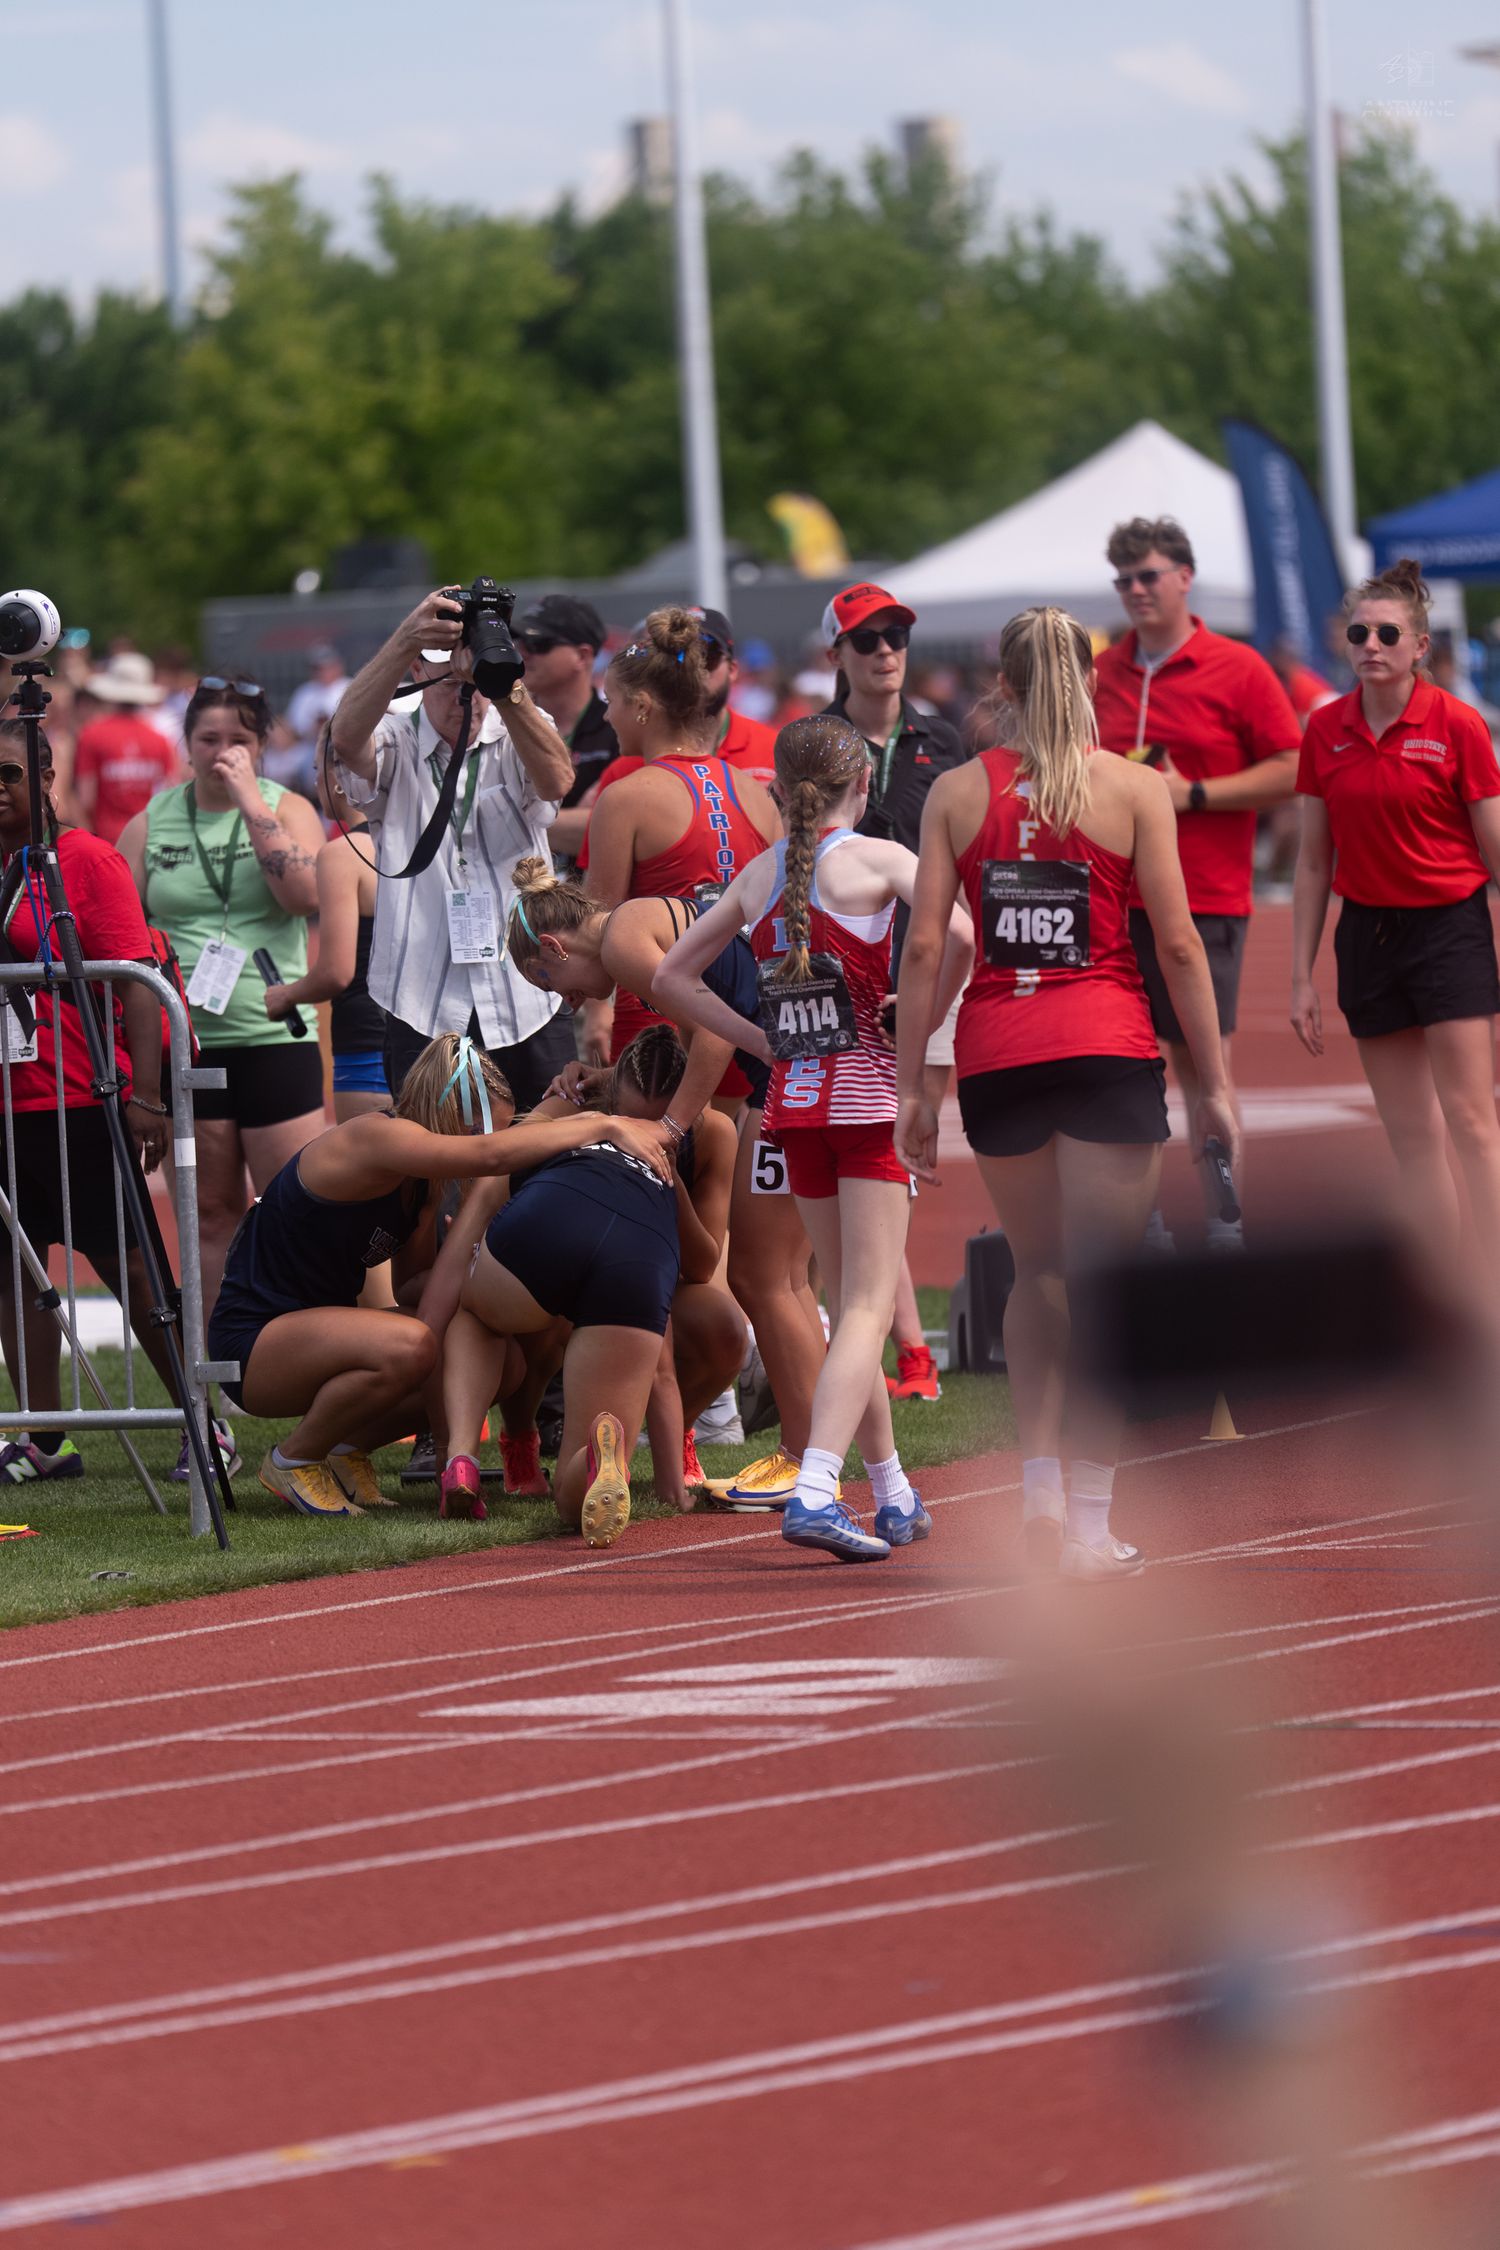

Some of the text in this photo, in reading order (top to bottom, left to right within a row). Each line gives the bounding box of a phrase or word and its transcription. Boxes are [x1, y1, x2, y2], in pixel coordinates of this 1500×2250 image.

[995, 907, 1075, 944] 4162
[778, 996, 840, 1035] 4114
[755, 1144, 784, 1191] 5
